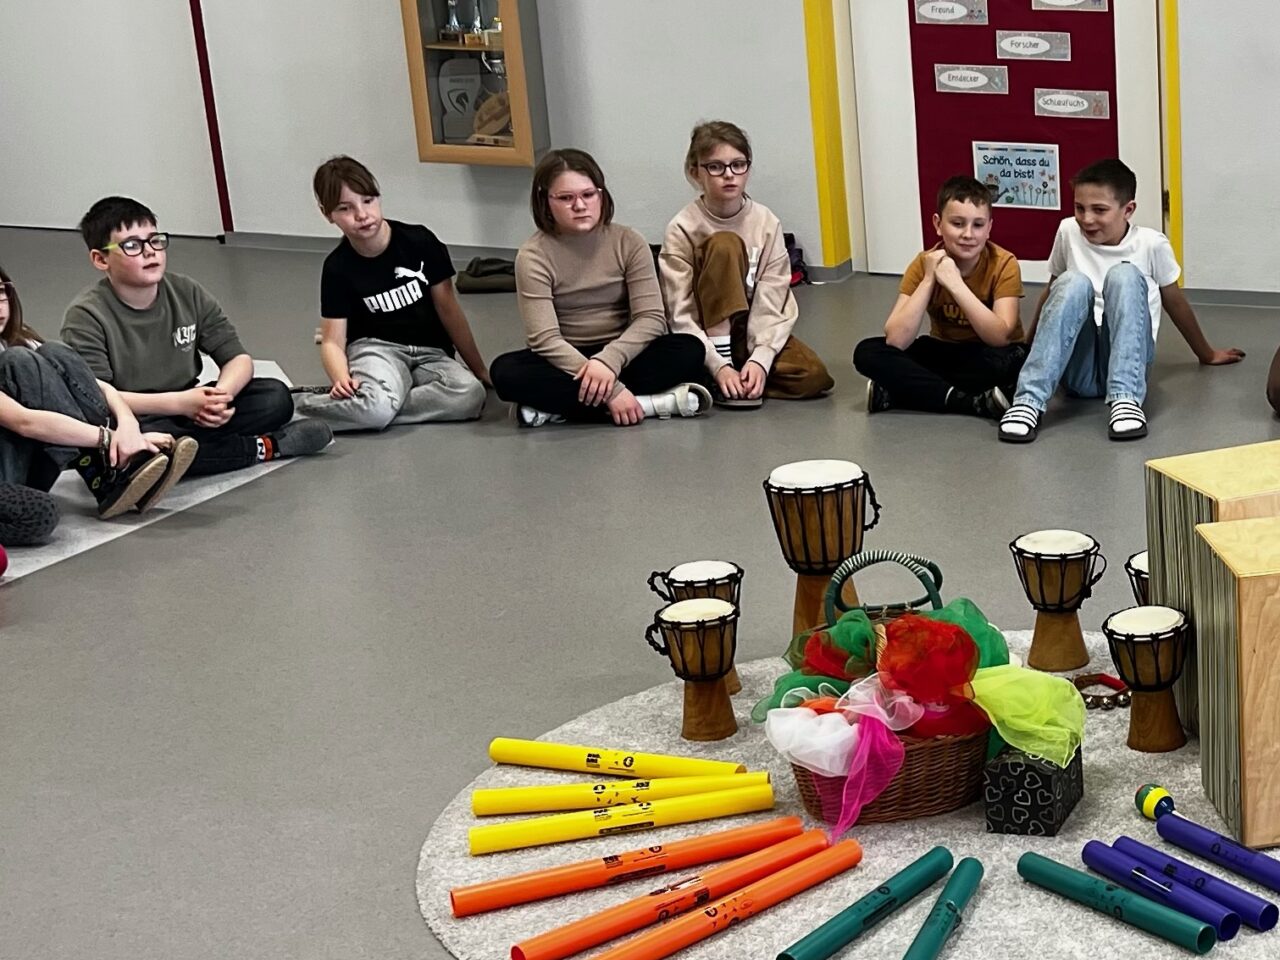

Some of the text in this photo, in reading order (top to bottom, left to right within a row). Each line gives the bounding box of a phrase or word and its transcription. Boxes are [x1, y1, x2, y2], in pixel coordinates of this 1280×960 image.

[931, 5, 955, 14] Freund
[1010, 40, 1040, 49] Forscher
[982, 155, 1050, 167] Schön, dass du
[1000, 169, 1034, 179] da bist!
[363, 279, 424, 313] PUMA
